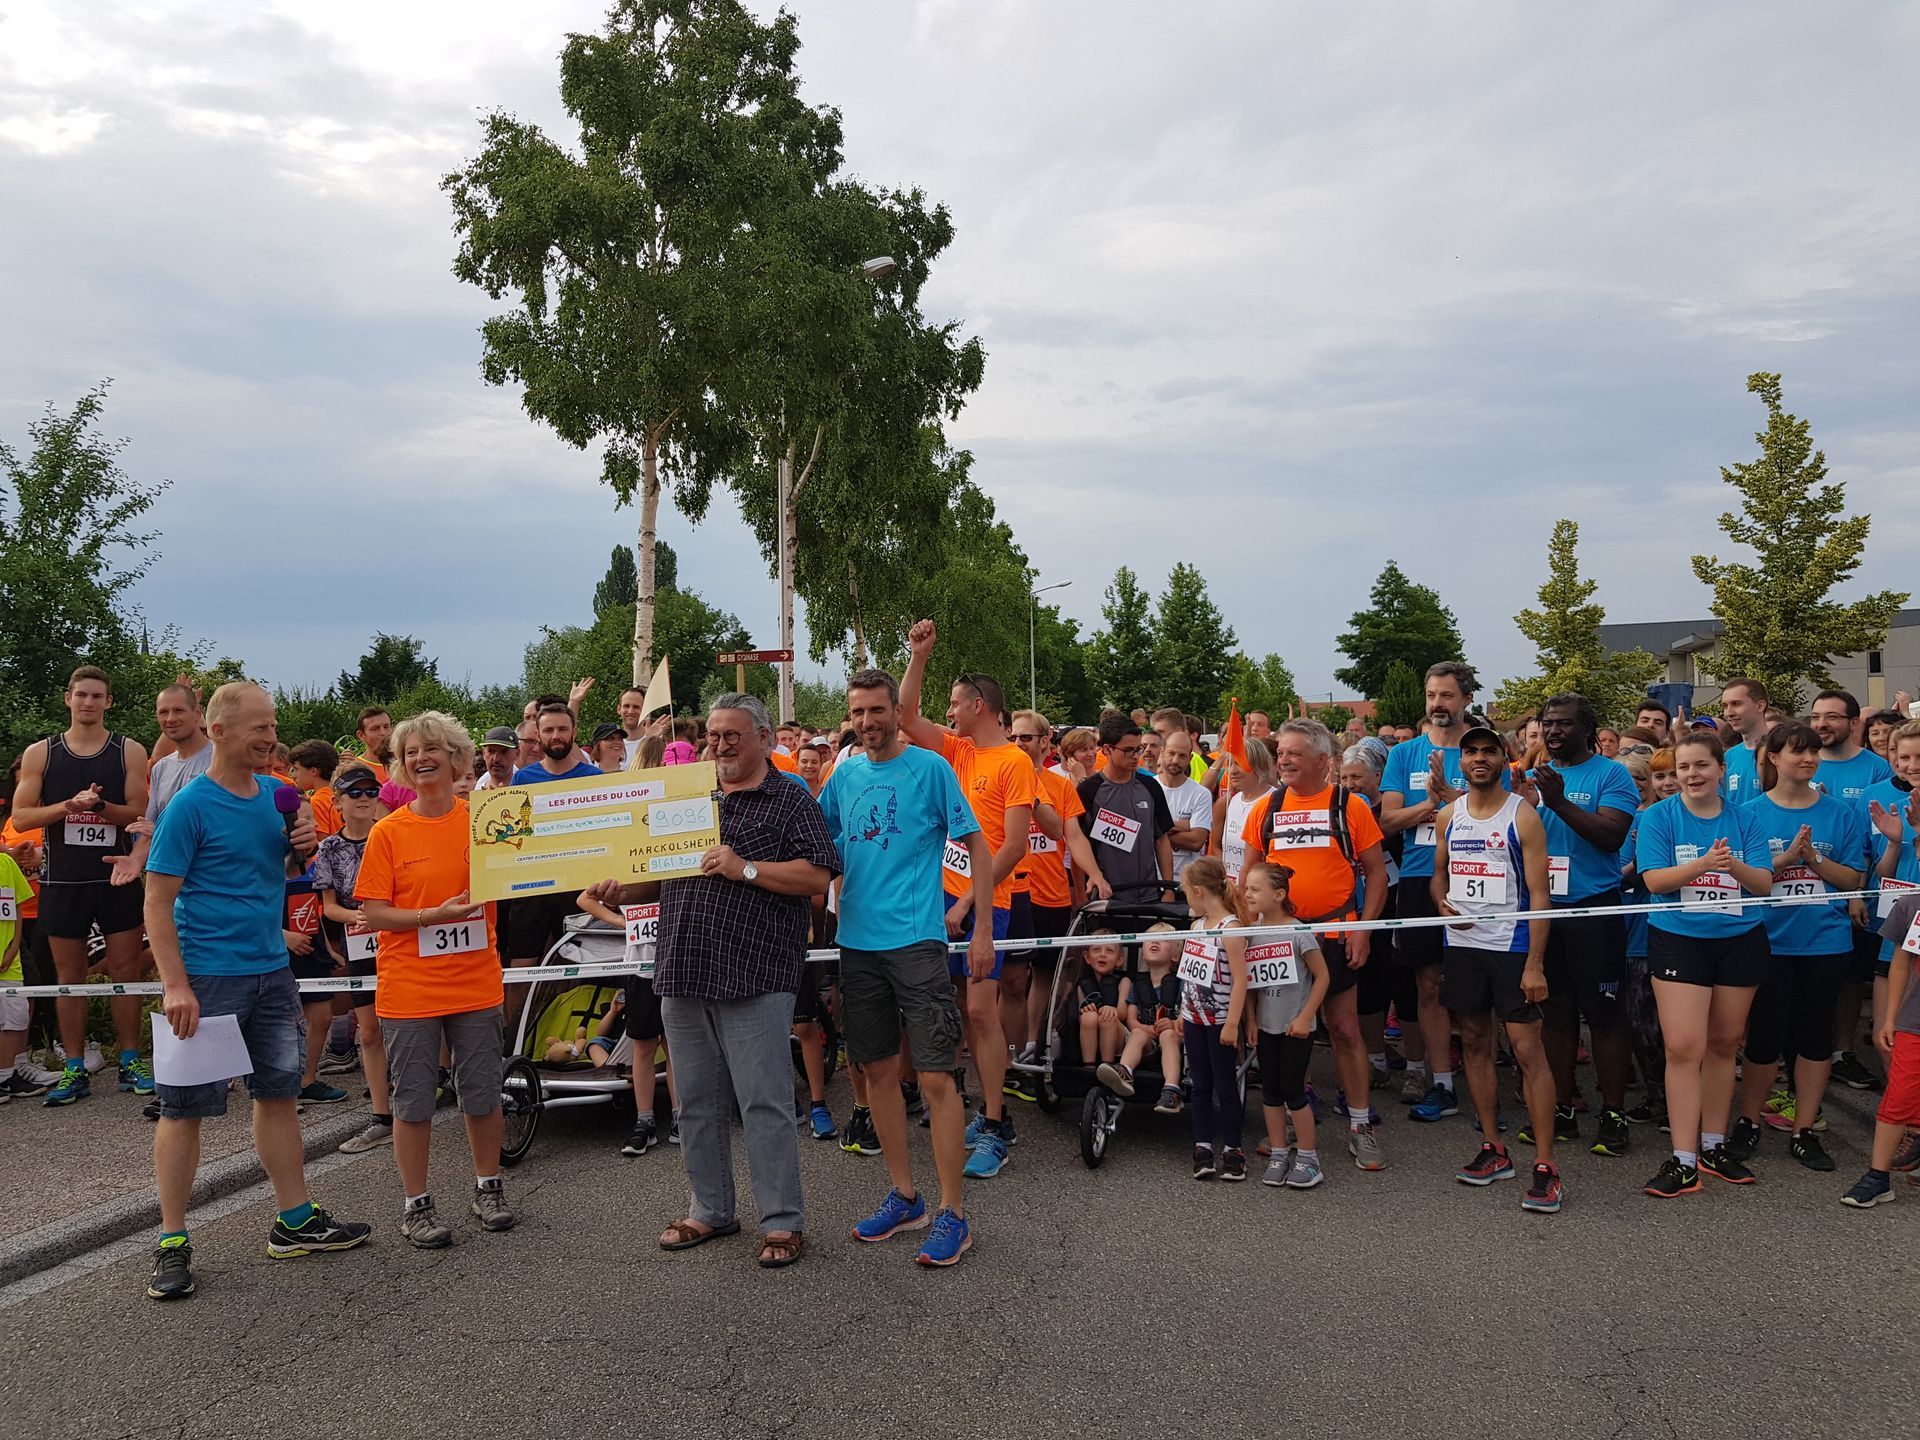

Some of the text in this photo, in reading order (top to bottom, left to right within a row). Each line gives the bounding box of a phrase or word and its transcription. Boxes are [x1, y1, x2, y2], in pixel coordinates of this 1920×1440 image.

[487, 791, 507, 803] CENTRE
[548, 788, 650, 808] LES FOULEES DU LOUP
[68, 814, 97, 823] SPORT
[655, 805, 708, 828] 9096
[1099, 811, 1123, 826] SPORT
[1276, 814, 1305, 825] SPORT
[77, 826, 106, 843] 194
[1101, 826, 1126, 845] 480
[629, 837, 717, 857] MARCKOLSHEIM
[632, 862, 648, 874] LE
[1452, 863, 1481, 874] SPORT
[1466, 879, 1485, 898] 51
[1782, 883, 1815, 896] 767
[627, 907, 653, 920] SPORT
[435, 925, 471, 951] 311
[1185, 942, 1200, 953] SPORT
[1245, 945, 1290, 960] SPORT 2000
[1183, 957, 1208, 981] 1466
[1250, 961, 1290, 983] 1502
